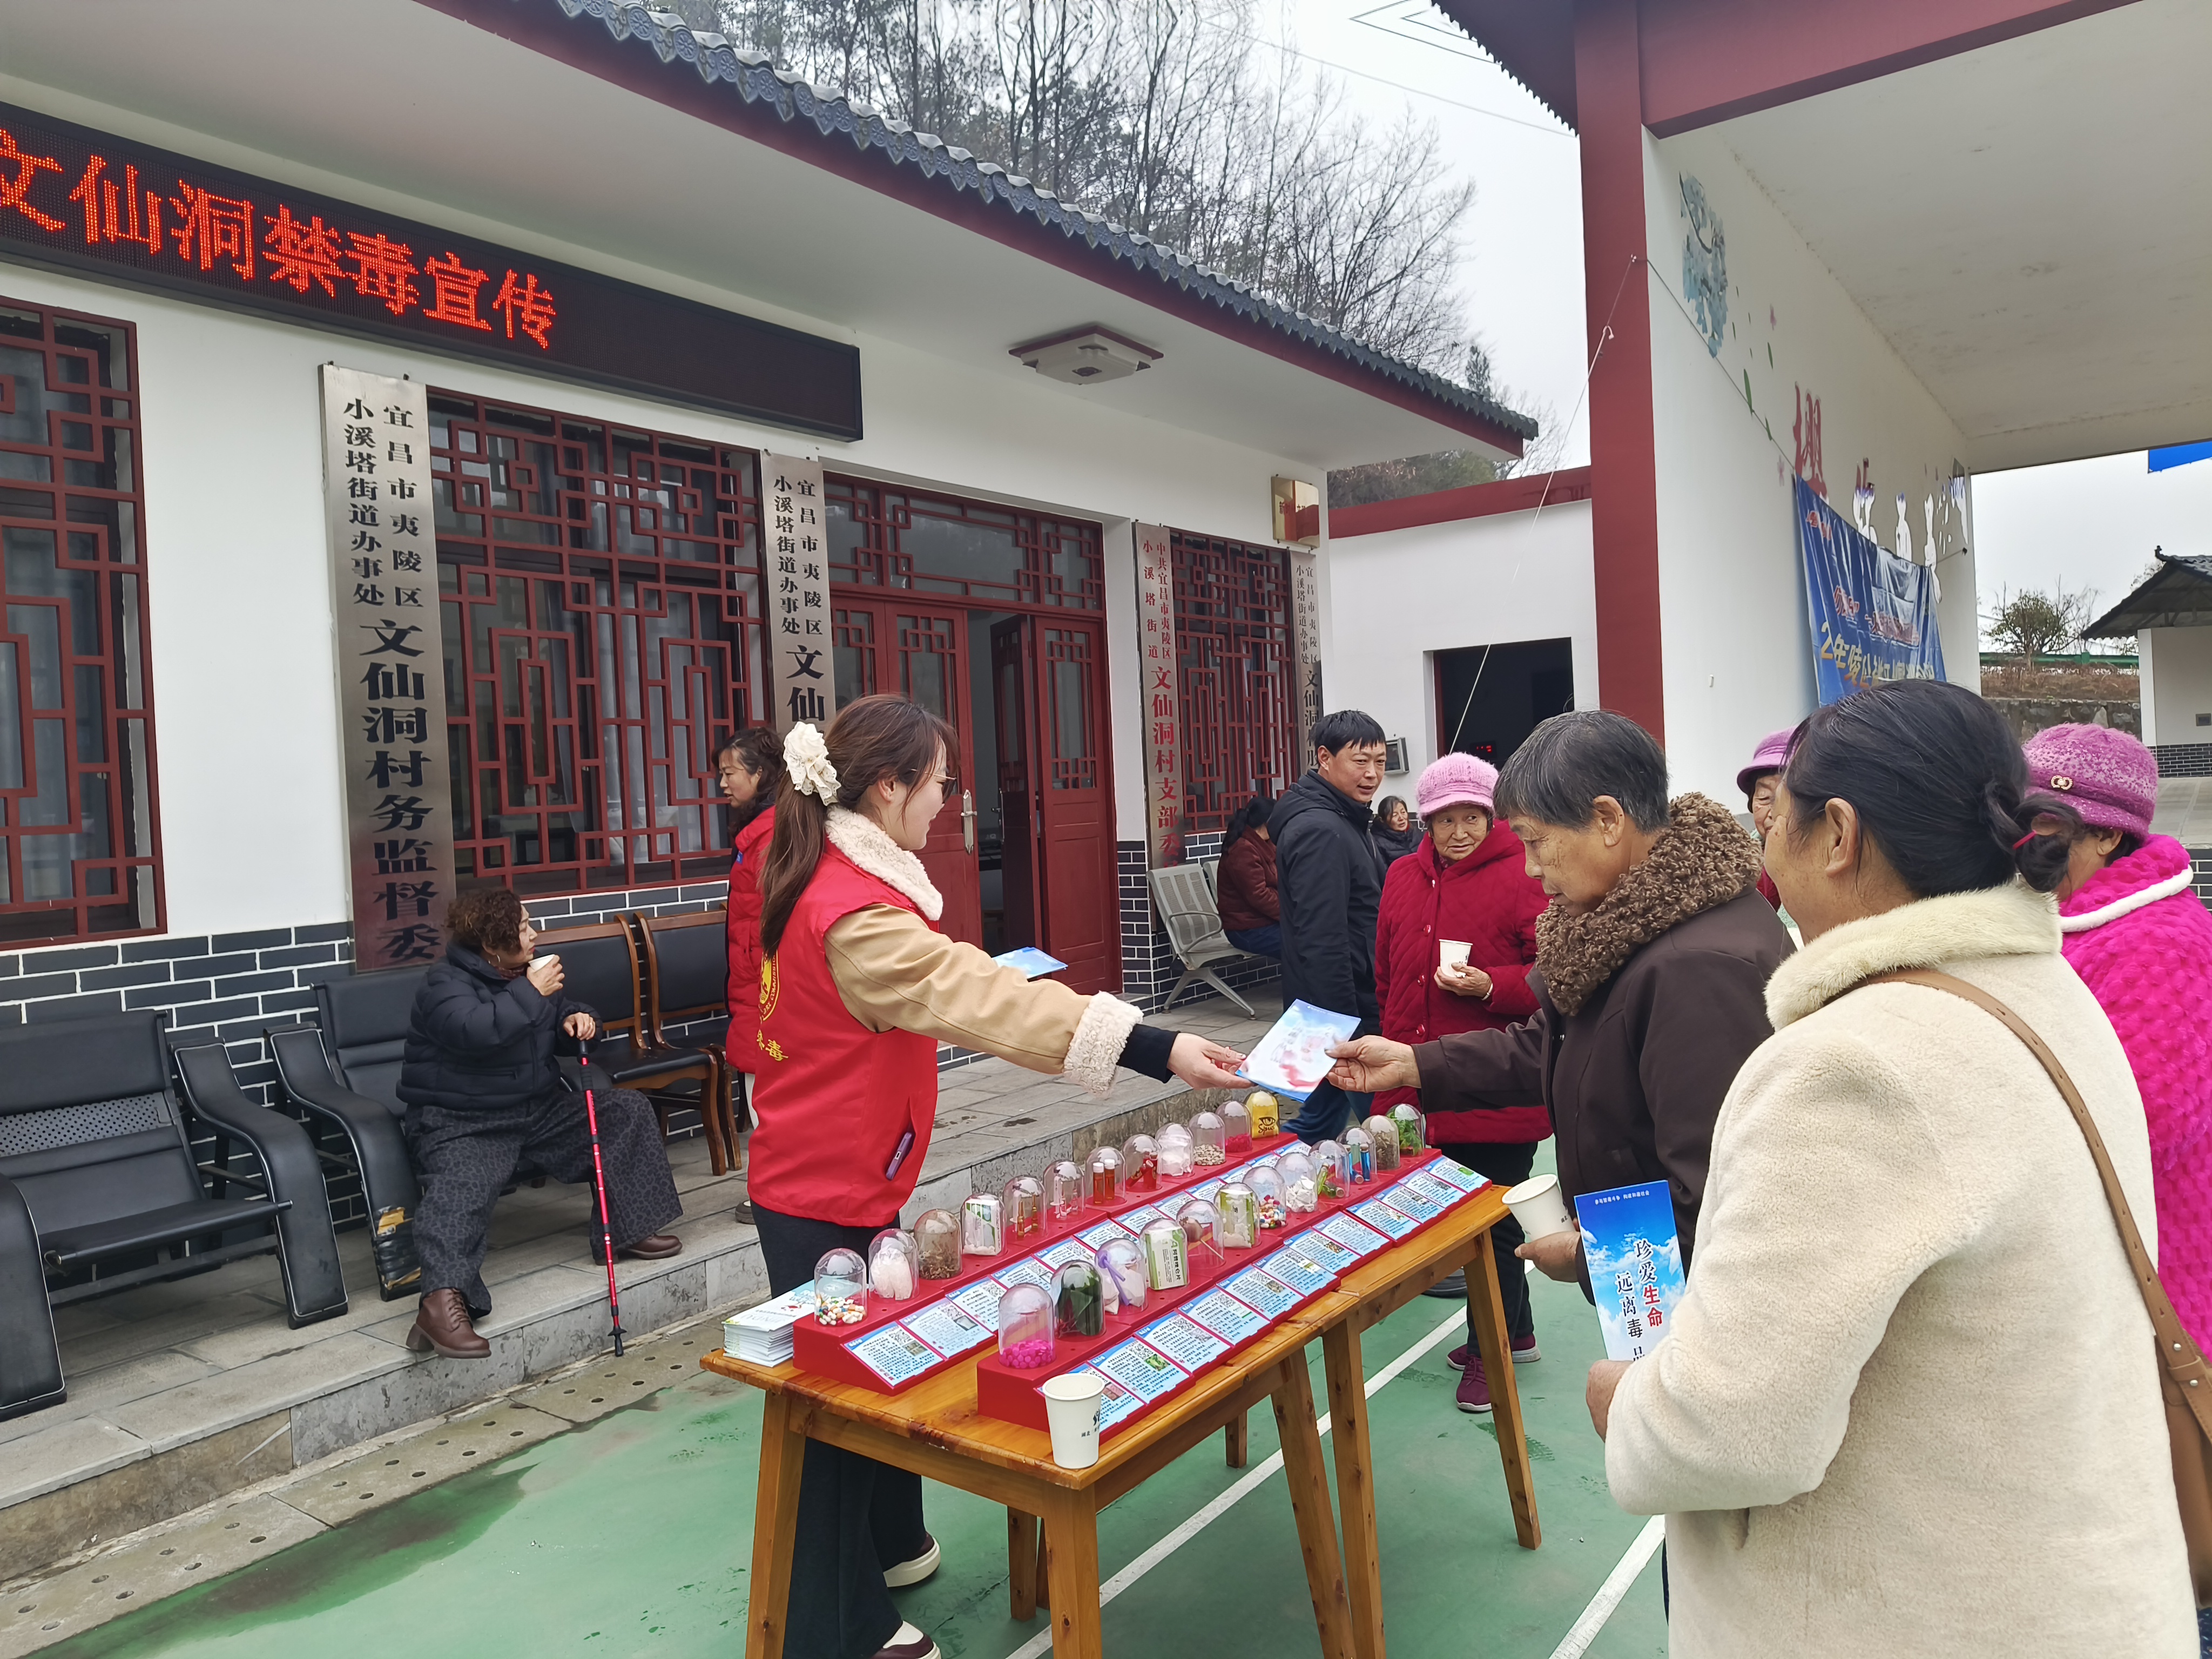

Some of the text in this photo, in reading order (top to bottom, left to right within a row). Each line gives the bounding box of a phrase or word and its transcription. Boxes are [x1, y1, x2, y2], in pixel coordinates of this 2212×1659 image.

[0, 128, 556, 349] 文仙洞禁毒宣传
[343, 397, 385, 606] 小溪塔街道办事处
[383, 405, 424, 608] 宜昌市夷陵区
[773, 475, 800, 635] 小溪塔街道办事处
[797, 480, 823, 636] 宜昌市夷陵区
[1142, 539, 1159, 658] 小溪塔街道
[1156, 542, 1172, 660] 中共宜昌市夷陵区
[786, 645, 825, 722] 文仙
[359, 618, 442, 965] 文仙洞村务监督委
[1151, 665, 1180, 868] 文仙洞村支部委
[1635, 1240, 1663, 1327] 珍爱生命
